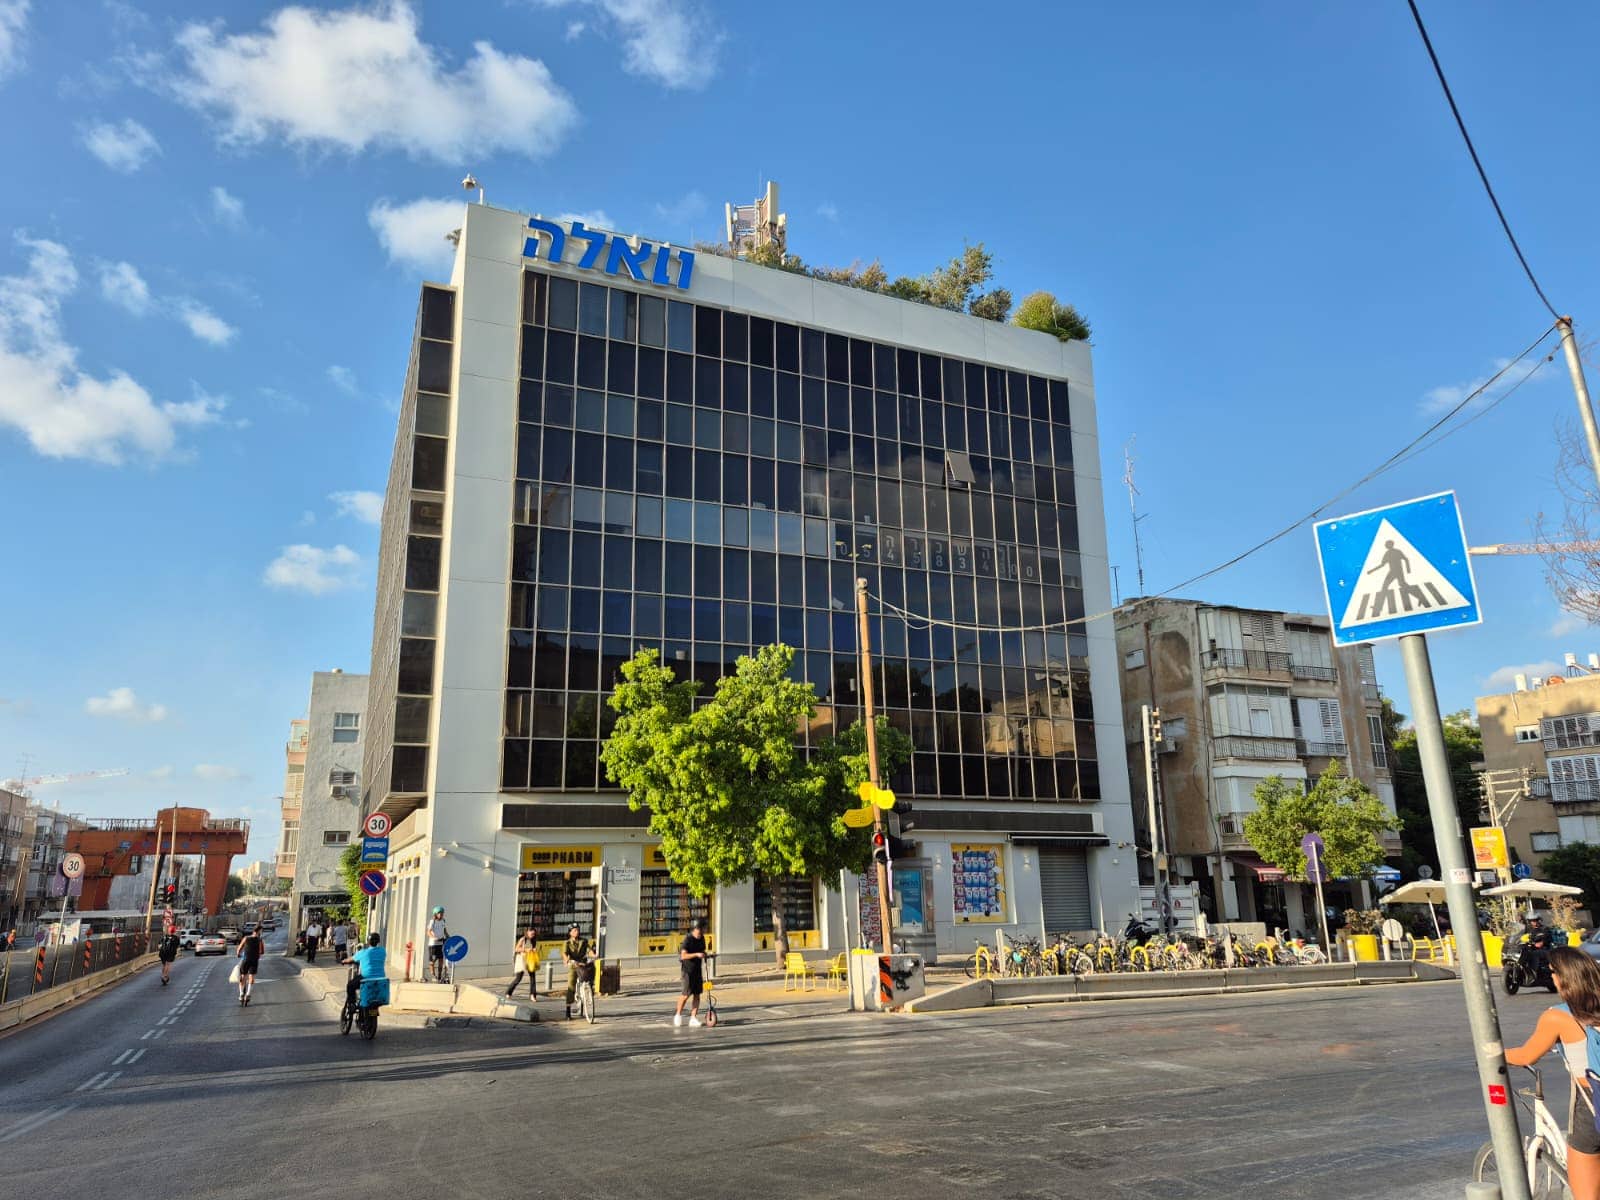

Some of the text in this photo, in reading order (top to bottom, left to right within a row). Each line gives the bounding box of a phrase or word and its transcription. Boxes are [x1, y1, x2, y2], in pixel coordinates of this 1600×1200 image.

[522, 217, 696, 290] וואלה
[885, 535, 1006, 561] להשכרה
[370, 819, 385, 830] 30
[552, 850, 593, 864] PHARM
[67, 860, 80, 872] 30
